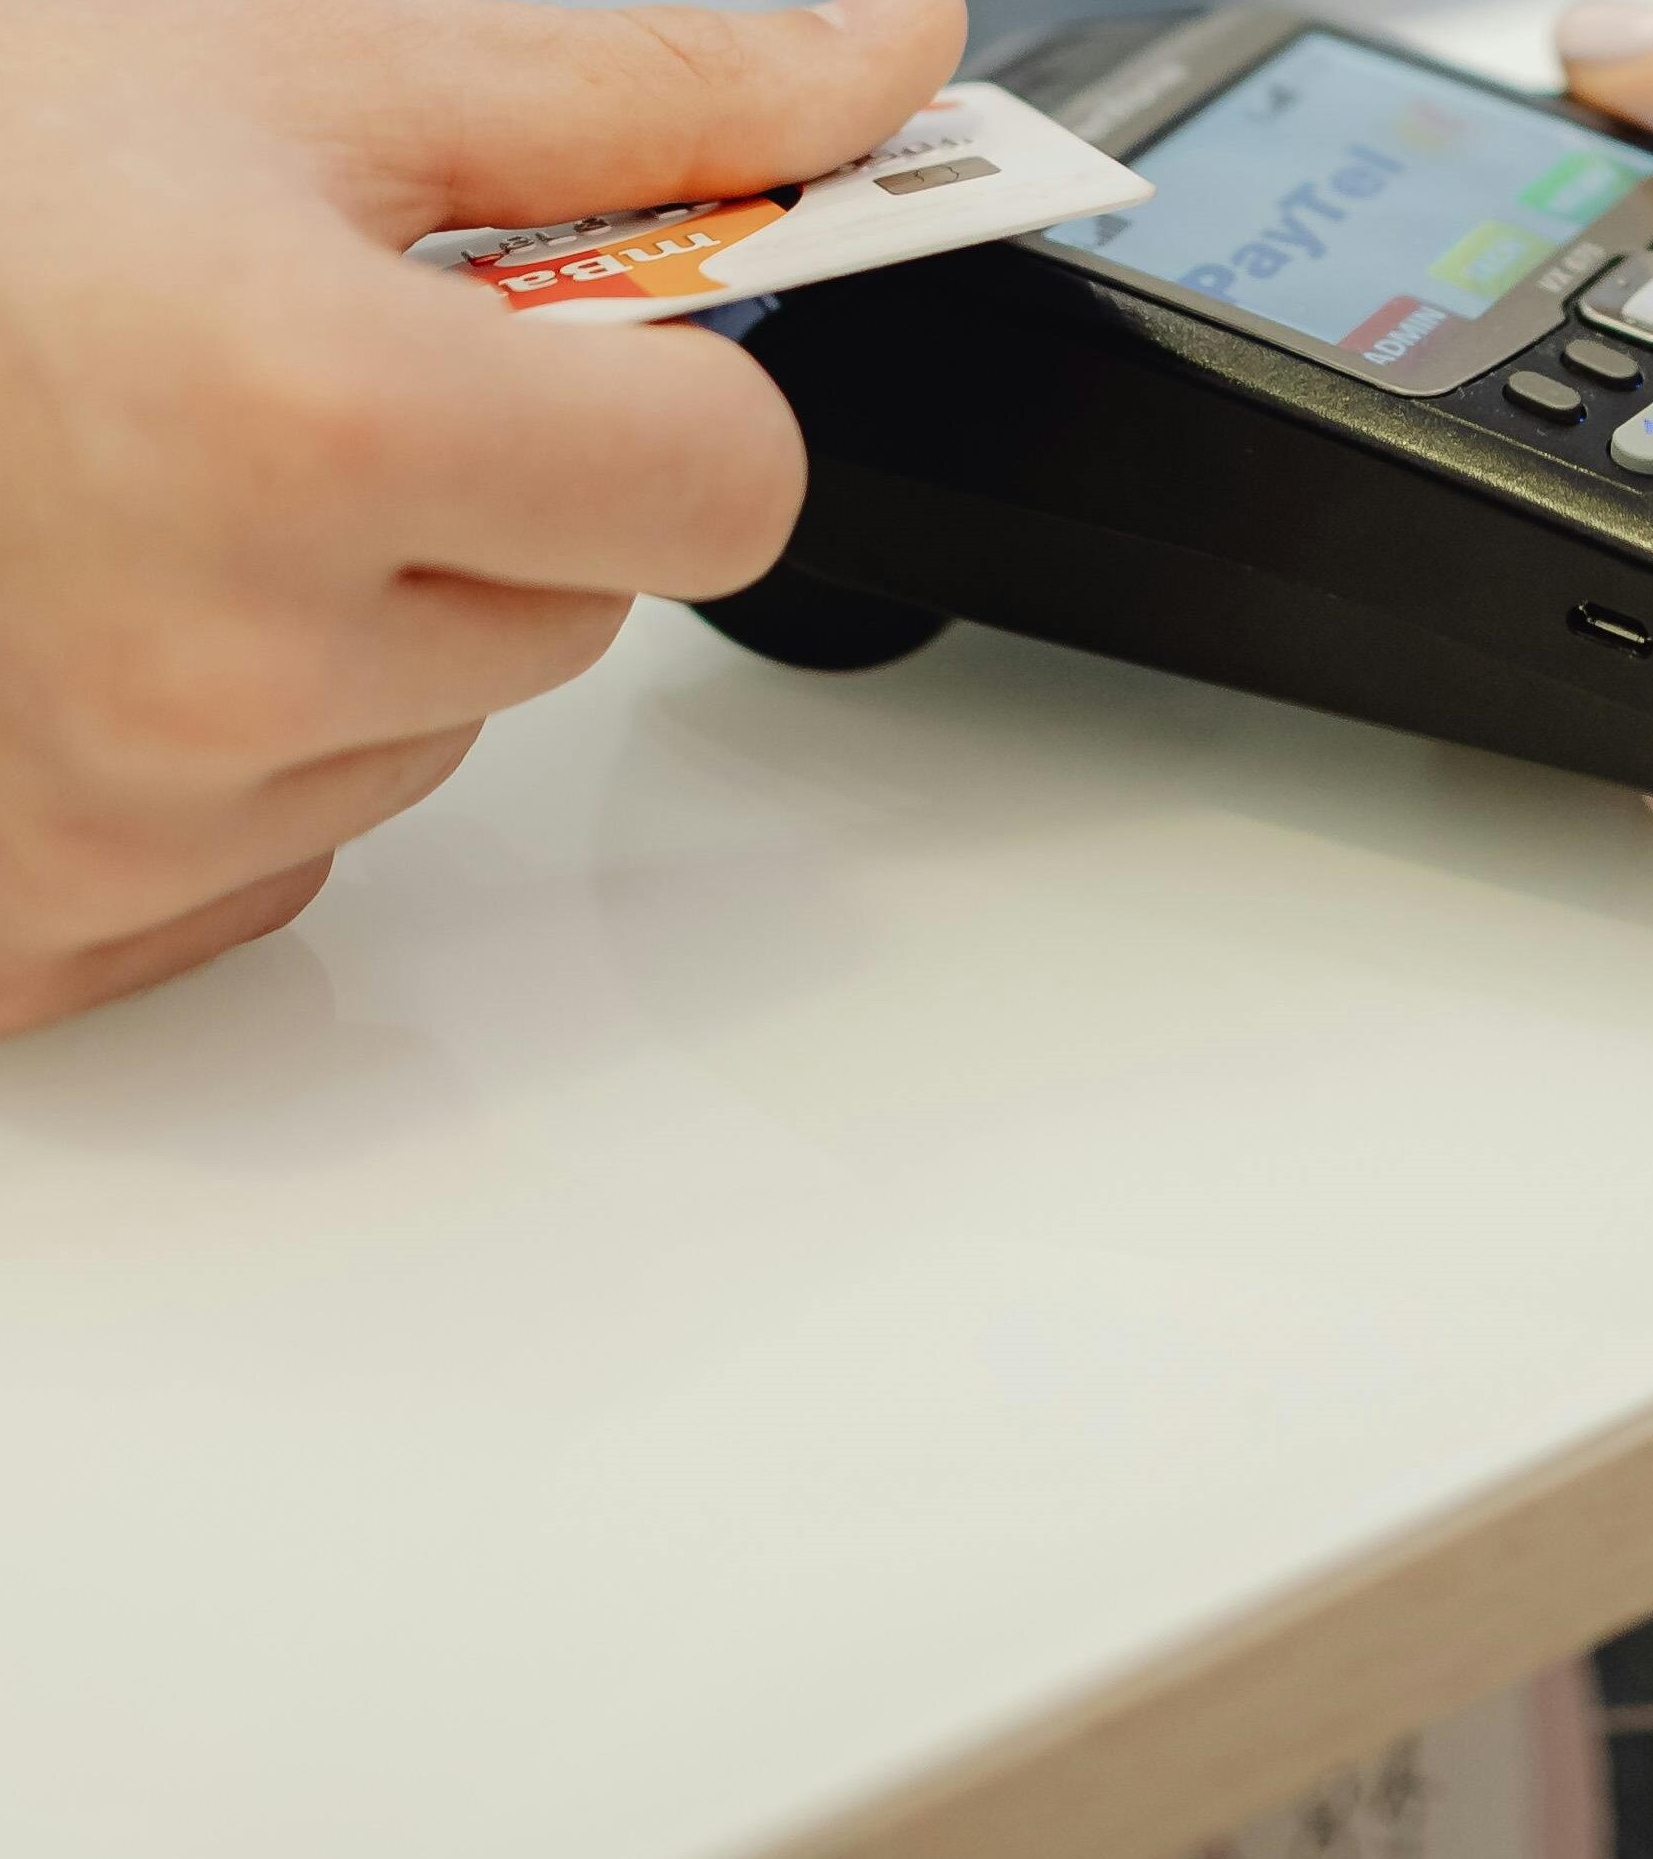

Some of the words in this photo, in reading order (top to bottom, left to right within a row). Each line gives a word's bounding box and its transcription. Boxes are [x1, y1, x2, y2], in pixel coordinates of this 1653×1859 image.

[1178, 142, 1406, 302] PayTel
[498, 232, 722, 295] mBa
[1363, 305, 1446, 366] ADMIN
